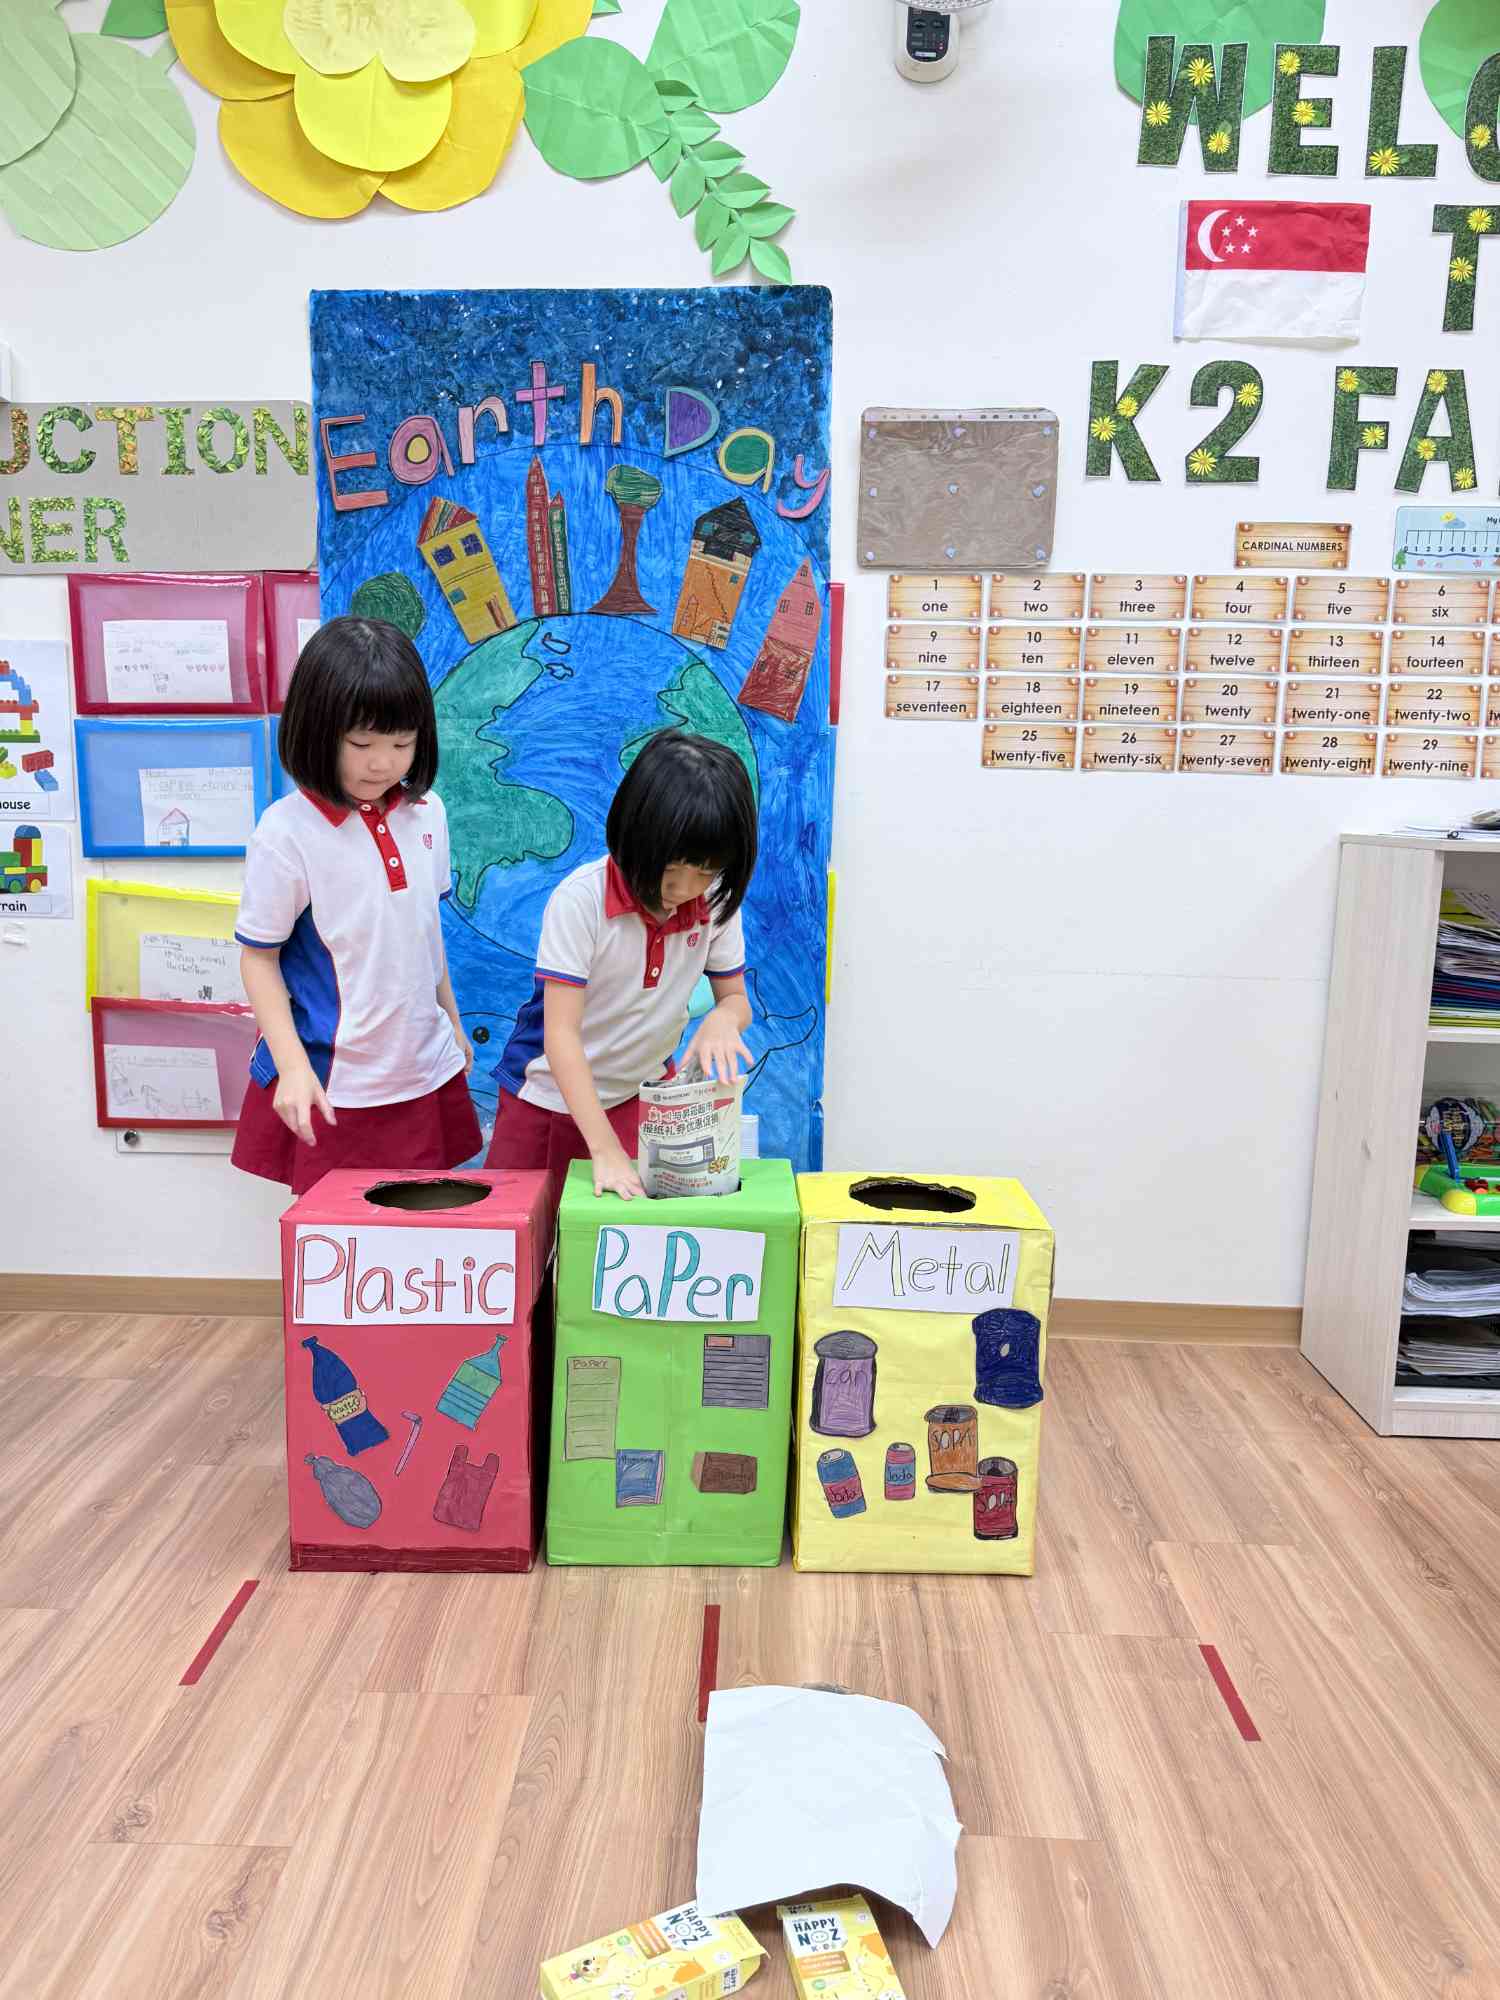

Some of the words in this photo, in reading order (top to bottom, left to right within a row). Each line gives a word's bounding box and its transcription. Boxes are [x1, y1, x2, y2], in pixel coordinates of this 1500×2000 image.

[1085, 359, 1264, 483] K2
[1327, 366, 1500, 493] FA
[319, 359, 623, 512] Earth
[663, 385, 831, 519] Day
[1242, 541, 1294, 551] CARDINAL
[1296, 542, 1343, 552] NUMBERS
[933, 579, 938, 591] 1
[1033, 579, 1041, 591] 2
[1134, 579, 1143, 592] 3
[1235, 580, 1244, 593] 4
[1337, 582, 1346, 594] 5
[1438, 585, 1446, 597] 6
[922, 601, 948, 612] one
[1024, 601, 1049, 613] two
[1119, 601, 1156, 613] three
[1225, 602, 1252, 615] four
[1327, 602, 1352, 615] five
[1431, 606, 1449, 618] six
[930, 630, 938, 642] 9
[1027, 631, 1042, 643] 10
[1126, 632, 1139, 644] 11
[1228, 633, 1242, 645] 12
[1330, 635, 1344, 647] 13
[1431, 635, 1445, 647] 14
[918, 652, 948, 664] nine
[1021, 652, 1043, 664] ten
[1107, 653, 1154, 665] eleven
[1210, 654, 1256, 666] twelve
[1308, 655, 1360, 668] thirteen
[1407, 655, 1464, 668] fourteen
[926, 680, 941, 692] 17
[1026, 681, 1041, 693] 18
[1124, 683, 1139, 695] 19
[1221, 684, 1238, 696] 20
[1325, 687, 1339, 699] 21
[1426, 688, 1443, 700] 22
[896, 701, 967, 713] seventeen
[1001, 702, 1062, 716] eighteen
[1099, 703, 1160, 716] nineteen
[1205, 704, 1252, 719] twenty
[1291, 707, 1371, 722] twenty-one
[1394, 708, 1471, 723] twenty-two
[1021, 729, 1038, 742] 25
[1121, 732, 1137, 744] 26
[1219, 734, 1236, 746] 27
[1321, 736, 1338, 748] 28
[1422, 738, 1439, 751] 29
[991, 749, 1066, 764] twenty-five
[1093, 752, 1162, 767] twenty-six
[1179, 754, 1271, 770] twenty-seven
[1283, 755, 1372, 772] twenty-eight
[1388, 758, 1469, 773] twenty-nine
[0, 900, 27, 912] rain
[842, 1230, 1011, 1297] Metal
[294, 1233, 514, 1319] Plastic
[682, 1907, 713, 1939] HAPPY
[793, 1917, 837, 1933] HAPPY
